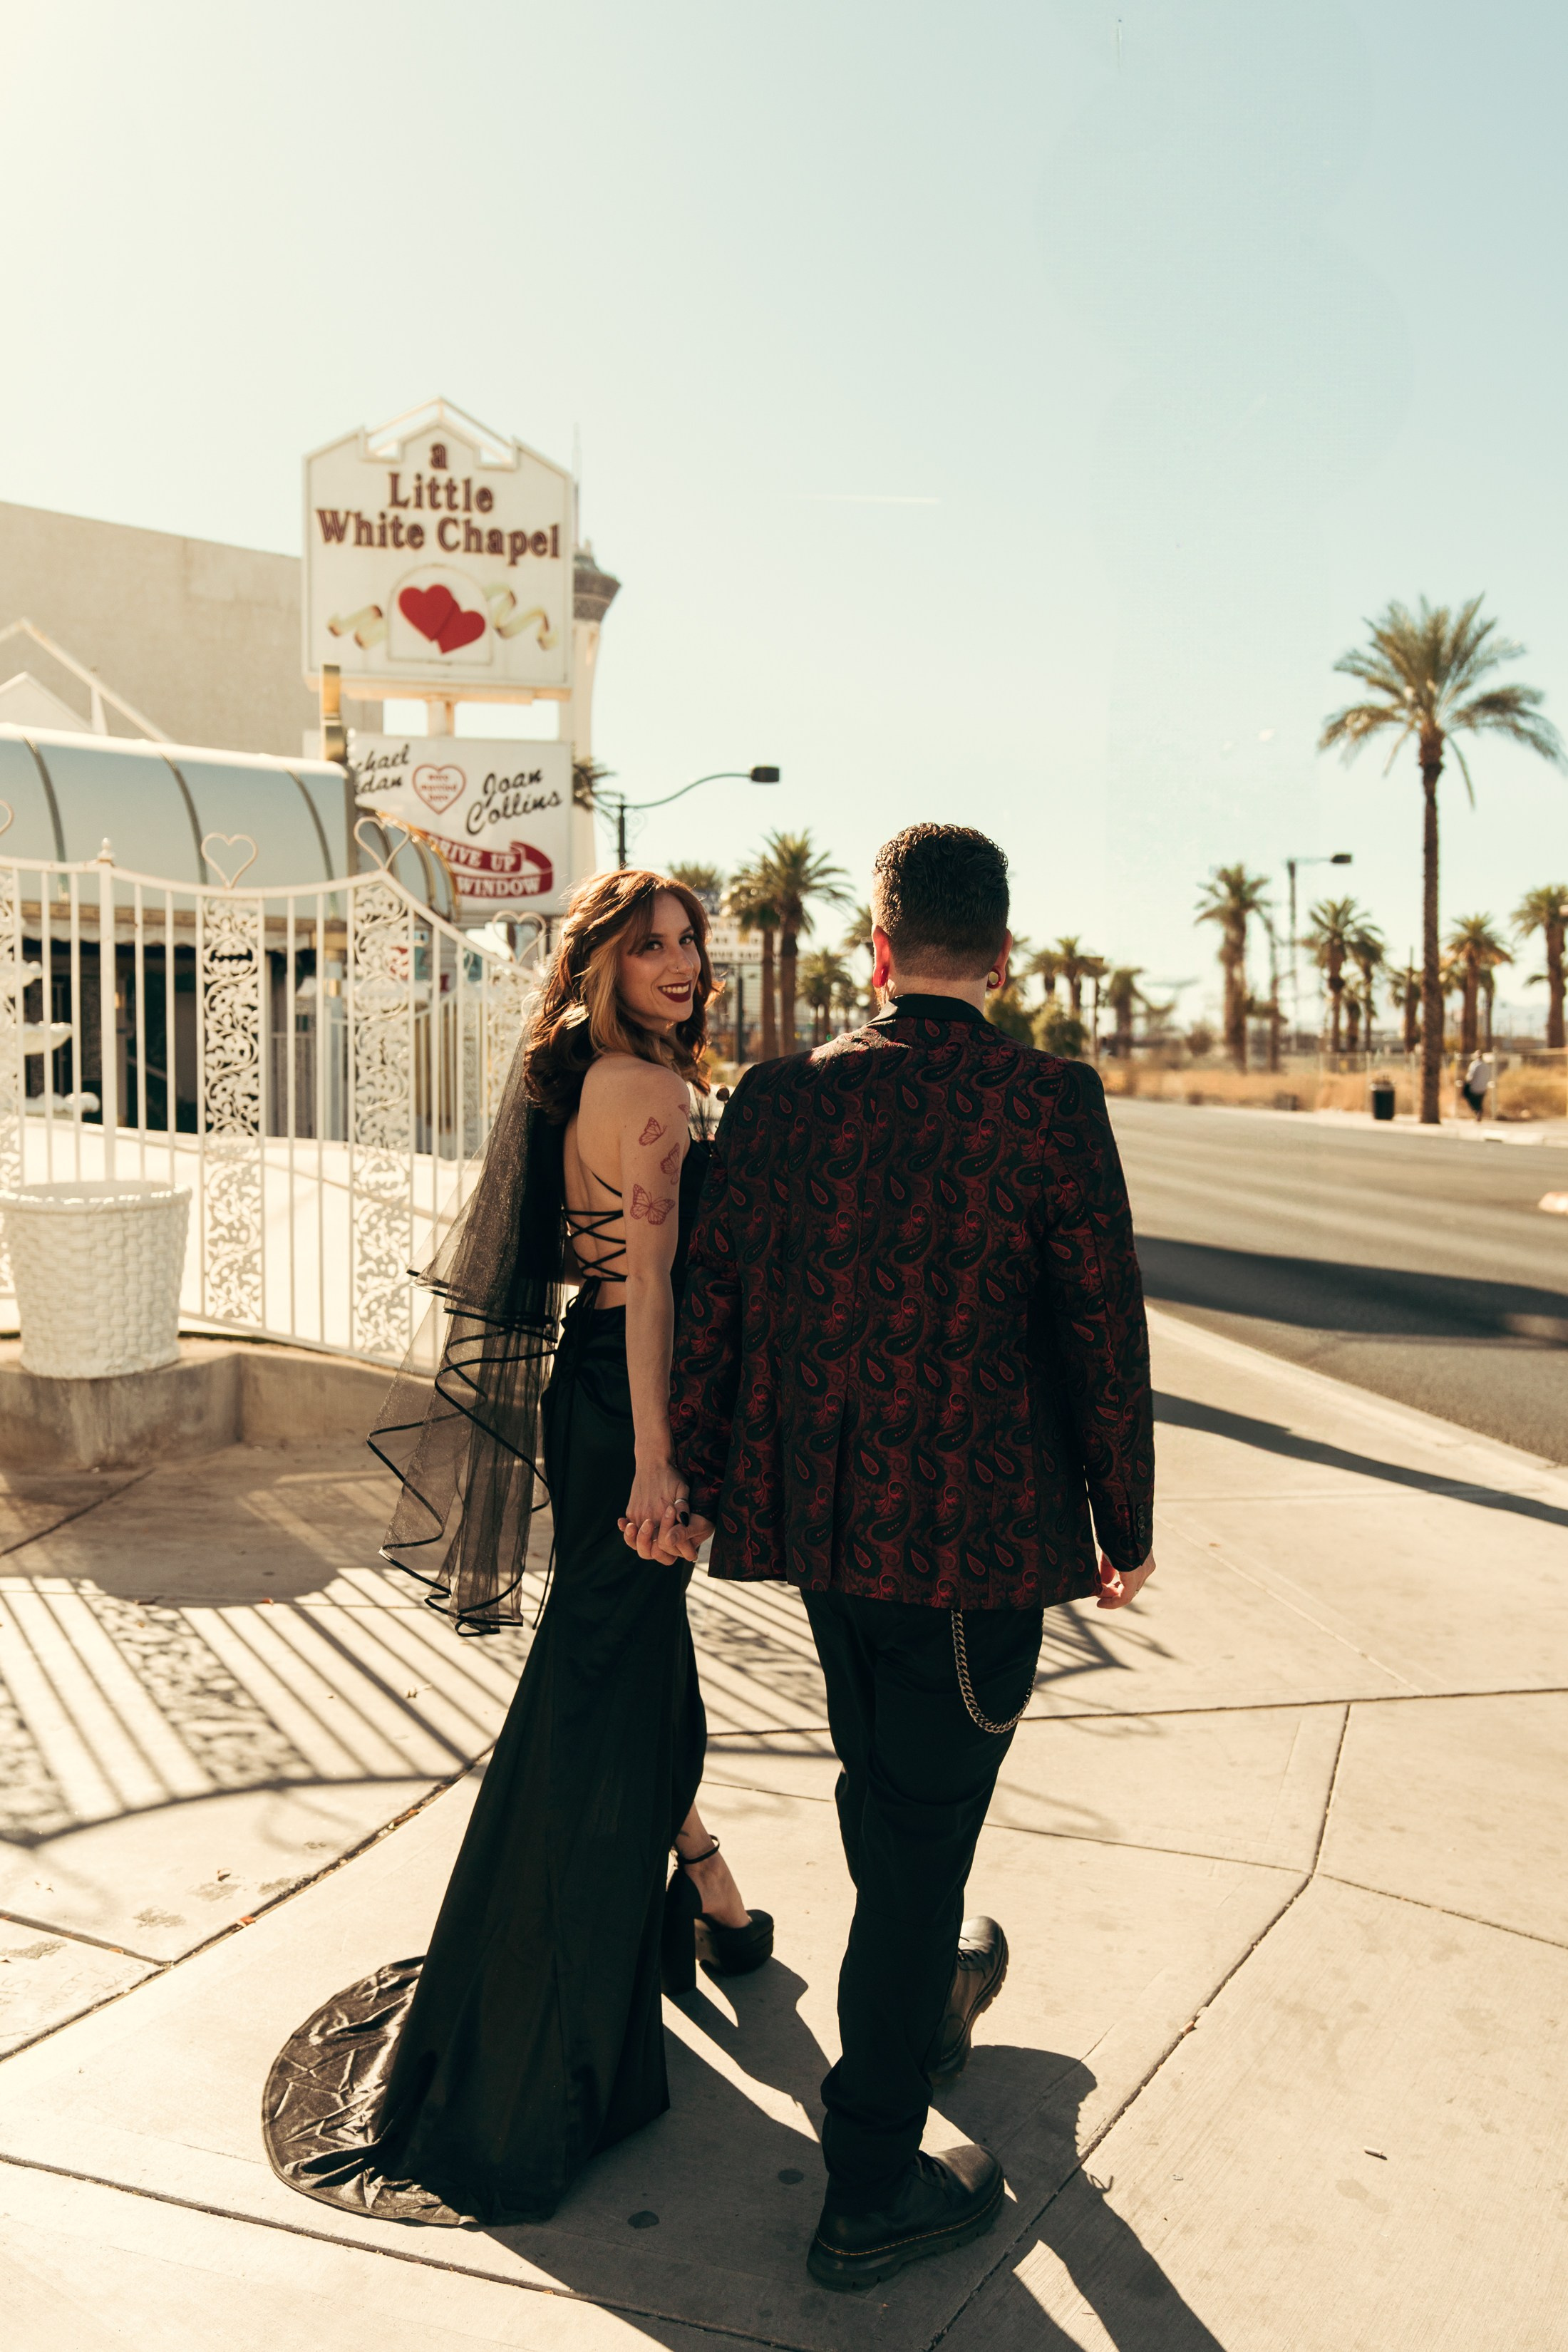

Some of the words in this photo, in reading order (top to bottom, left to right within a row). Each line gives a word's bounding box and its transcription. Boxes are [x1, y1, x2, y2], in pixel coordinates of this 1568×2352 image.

[430, 443, 448, 470] a
[388, 472, 494, 513] Little
[316, 509, 425, 550] White
[438, 517, 561, 567] Chapel
[483, 768, 543, 808] Joan
[466, 790, 563, 836] Collins
[490, 854, 517, 871] UP
[456, 875, 541, 897] WINDOW
